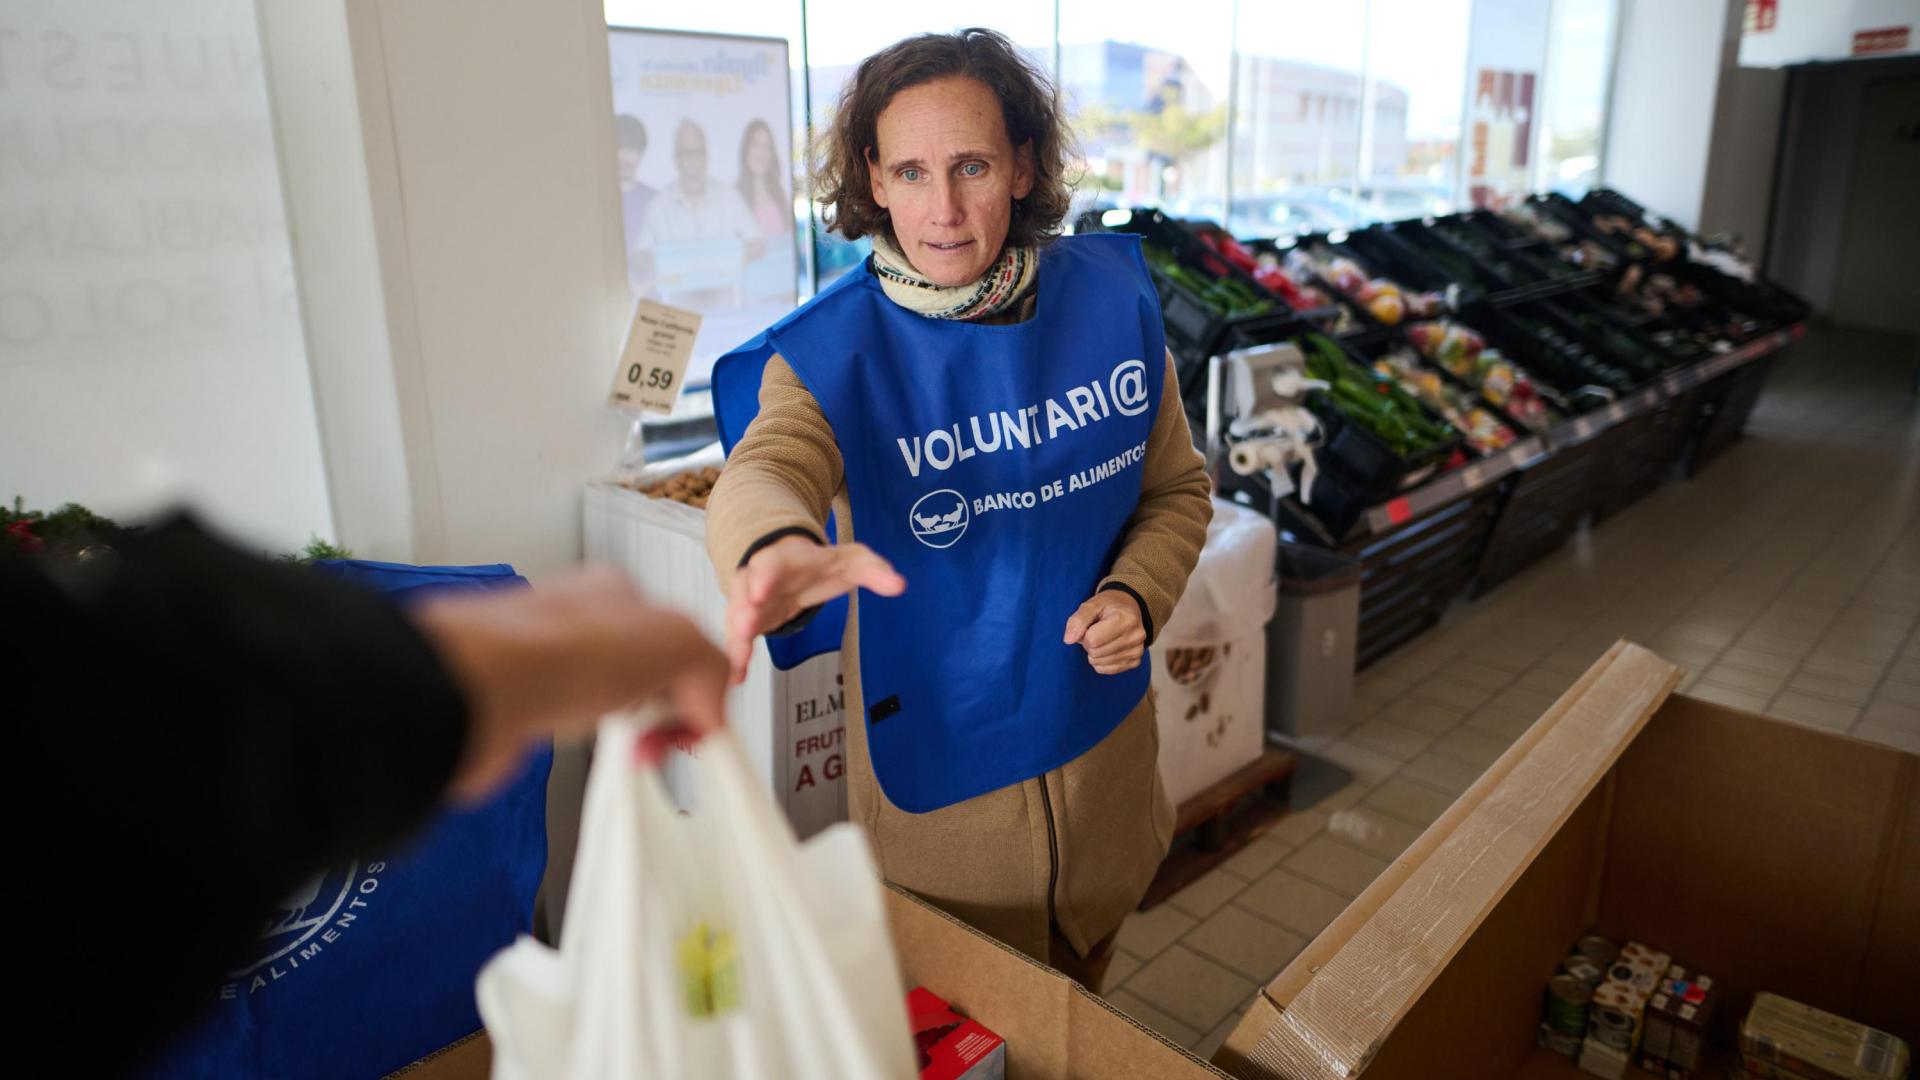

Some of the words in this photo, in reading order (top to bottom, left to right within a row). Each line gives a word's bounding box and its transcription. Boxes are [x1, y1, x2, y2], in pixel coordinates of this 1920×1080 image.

[628, 363, 672, 390] 0,59
[897, 359, 1149, 477] VOLUNTARI@
[973, 491, 1036, 516] BANCO
[1040, 480, 1065, 502] DE
[1068, 441, 1146, 493] ALIMENTOS
[795, 726, 846, 758] FRUT
[823, 752, 846, 780] G
[250, 861, 386, 994] ALIMENTOS
